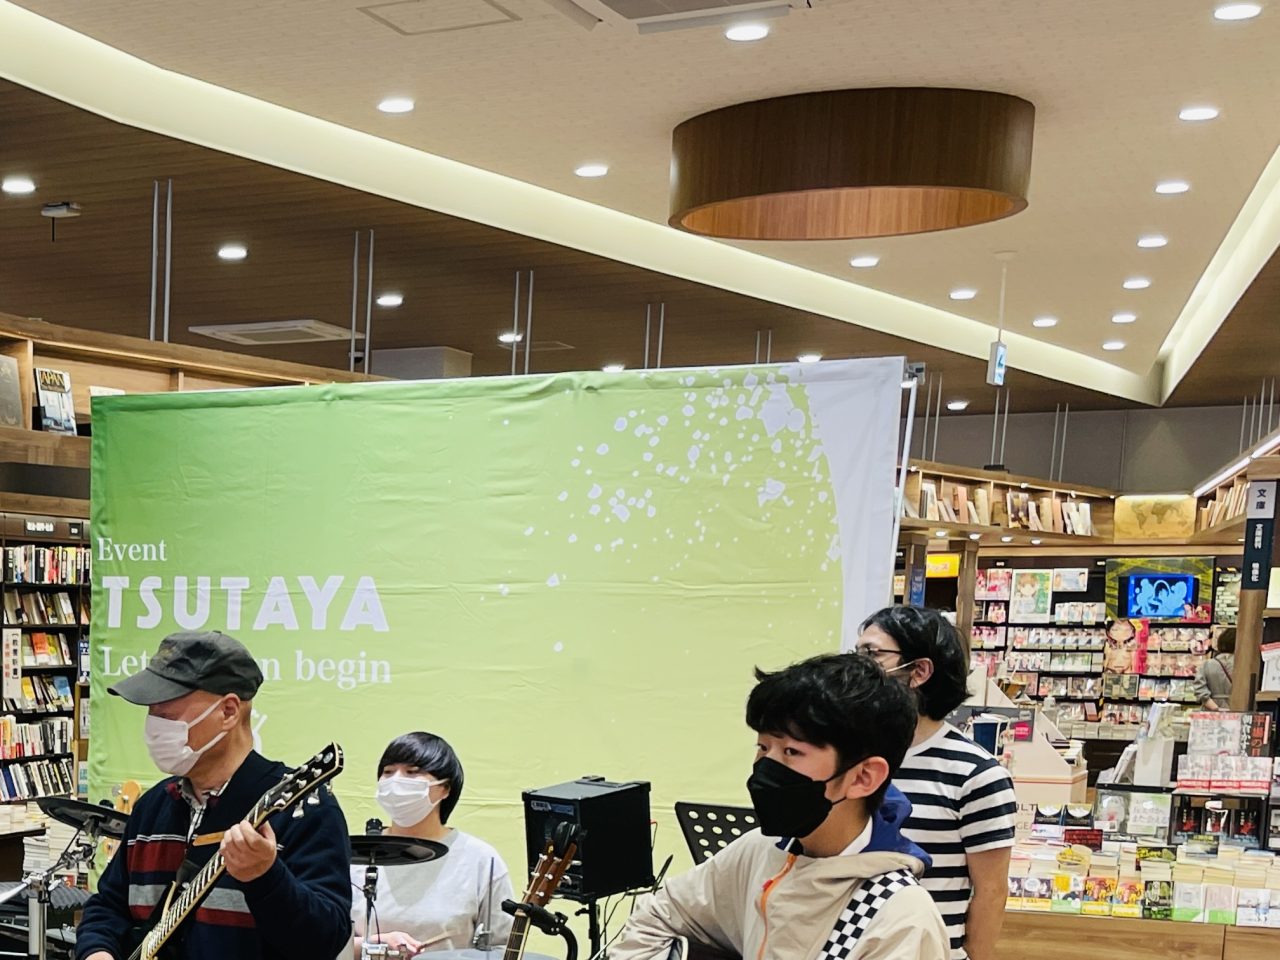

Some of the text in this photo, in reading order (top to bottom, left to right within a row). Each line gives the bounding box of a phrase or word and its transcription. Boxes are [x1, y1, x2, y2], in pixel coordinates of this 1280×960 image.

[97, 537, 168, 562] Event
[102, 575, 390, 632] TSUTAYA
[295, 649, 392, 691] begin
